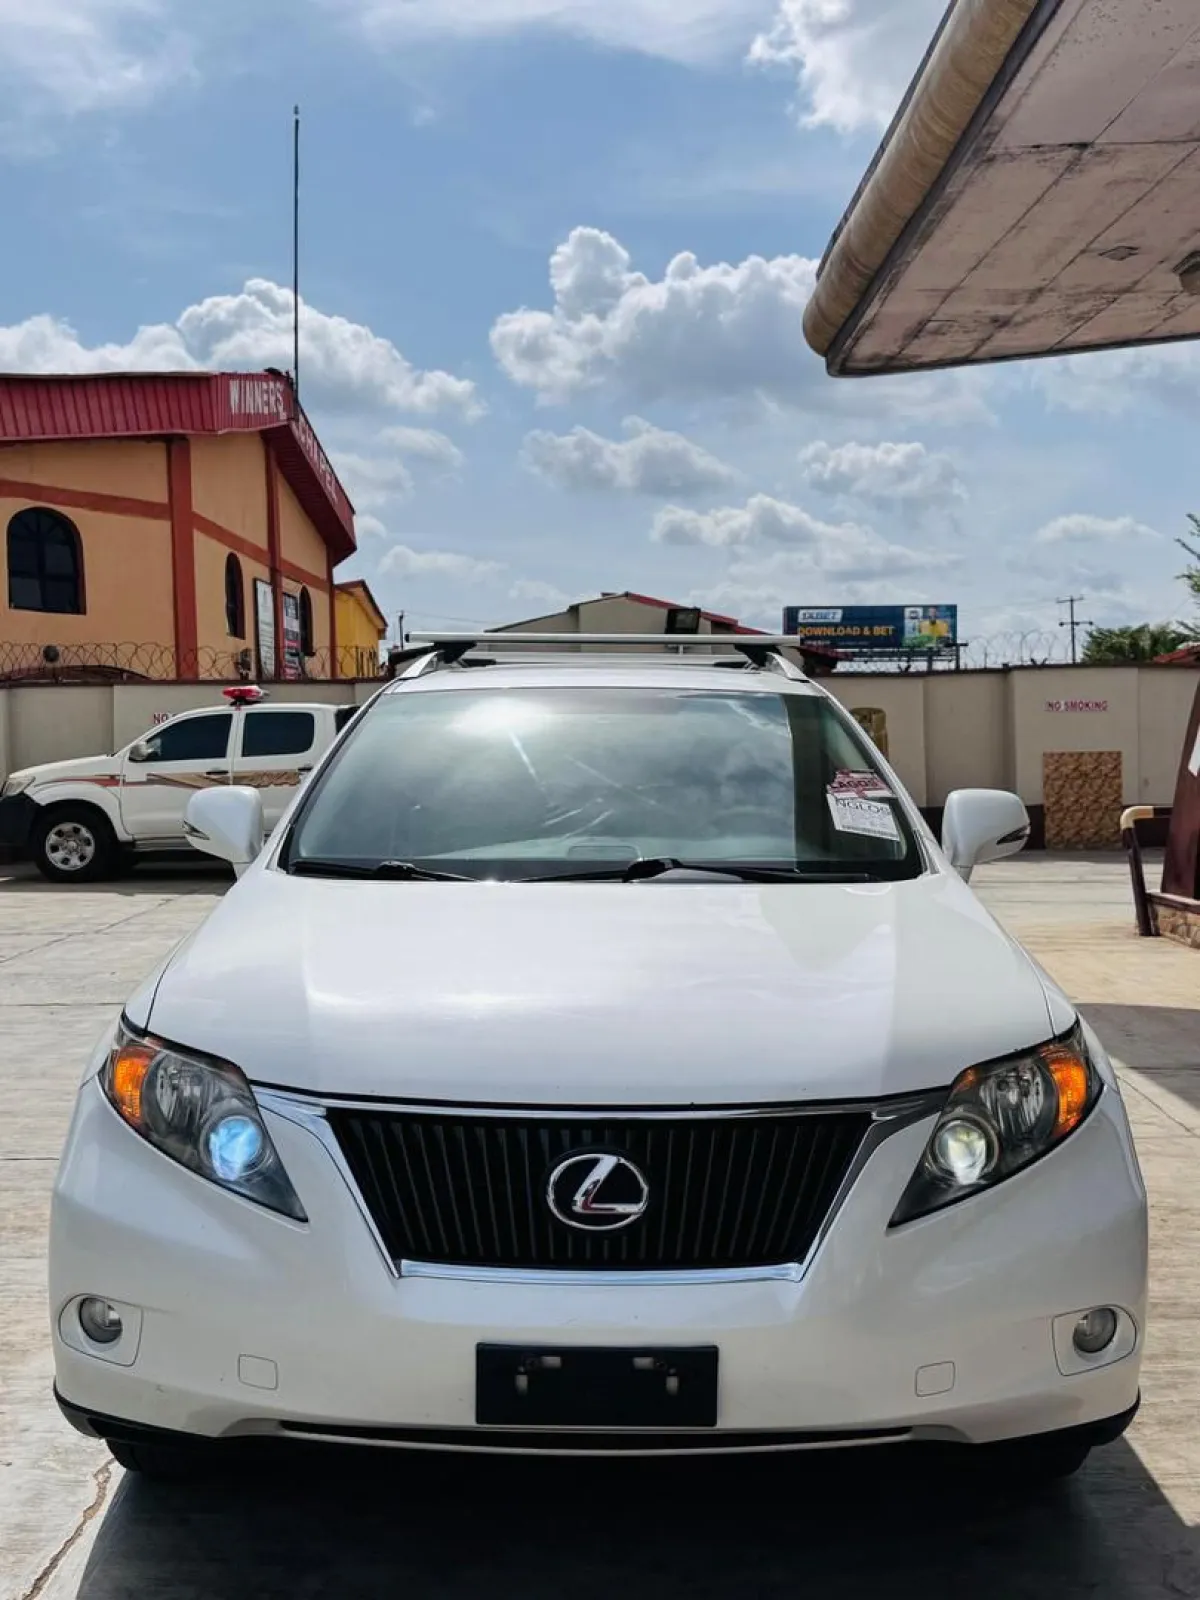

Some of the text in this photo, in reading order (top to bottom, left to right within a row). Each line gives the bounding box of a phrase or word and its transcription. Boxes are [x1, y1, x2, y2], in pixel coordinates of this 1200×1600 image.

[799, 625, 895, 637] DOWNLOAD & BET
[1047, 701, 1109, 711] NO SMOKING
[153, 713, 168, 724] NO
